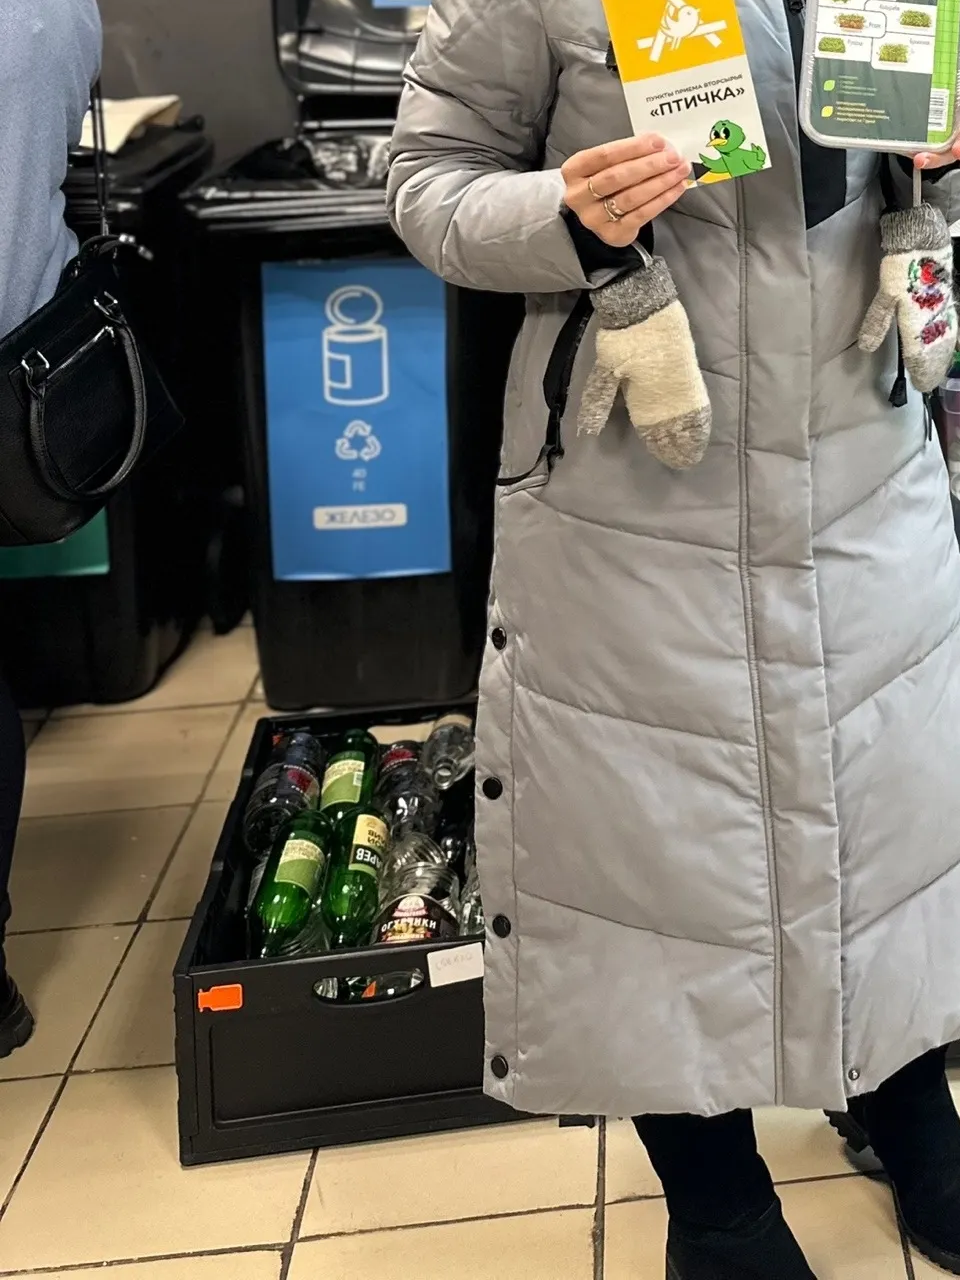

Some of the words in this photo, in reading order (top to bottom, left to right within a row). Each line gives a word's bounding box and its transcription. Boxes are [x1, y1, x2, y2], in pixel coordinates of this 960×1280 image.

[646, 91, 674, 103] ПУНКТЫ
[703, 74, 743, 88] ВТОРСЫРЬЯ
[650, 86, 745, 117] «ПТИЧКА»
[324, 508, 396, 525] ЖЕЛЕЗО
